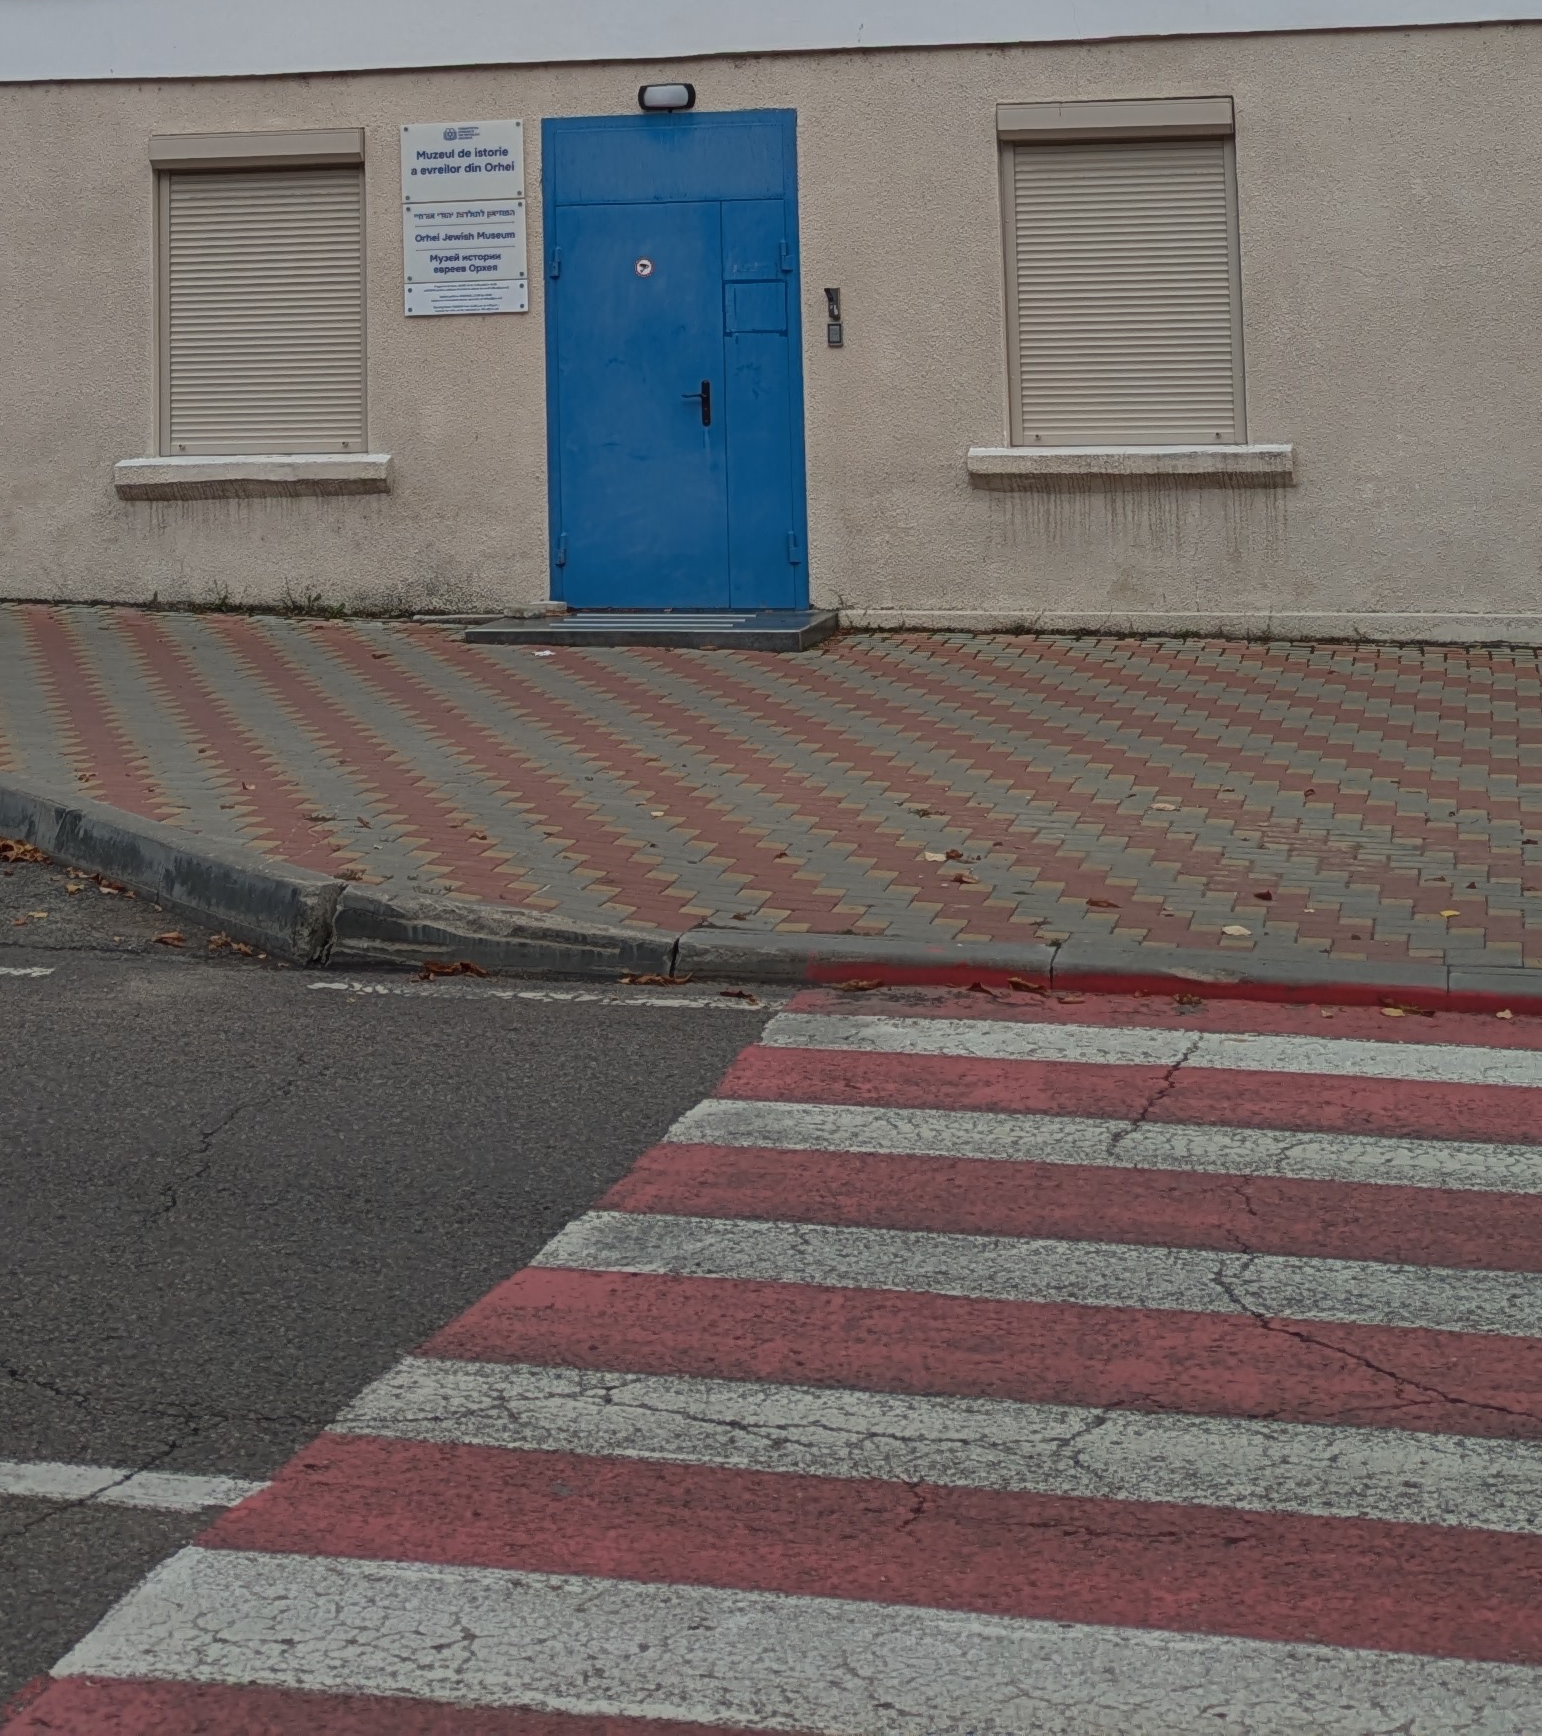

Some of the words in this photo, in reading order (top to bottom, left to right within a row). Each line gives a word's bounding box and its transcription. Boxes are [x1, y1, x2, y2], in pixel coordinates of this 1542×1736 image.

[416, 149, 455, 160] Muzeul
[457, 148, 471, 158] de
[474, 147, 509, 157] istorie
[411, 167, 417, 175] a
[420, 164, 461, 175] evreilor
[464, 162, 481, 173] din
[484, 161, 514, 172] Orhei
[415, 232, 440, 242] Orhei
[442, 231, 474, 242] Jewish
[477, 231, 515, 240] Museum
[430, 253, 459, 264] Музей
[461, 253, 501, 262] истории
[433, 265, 466, 275] евреев
[468, 264, 498, 274] Орхея
